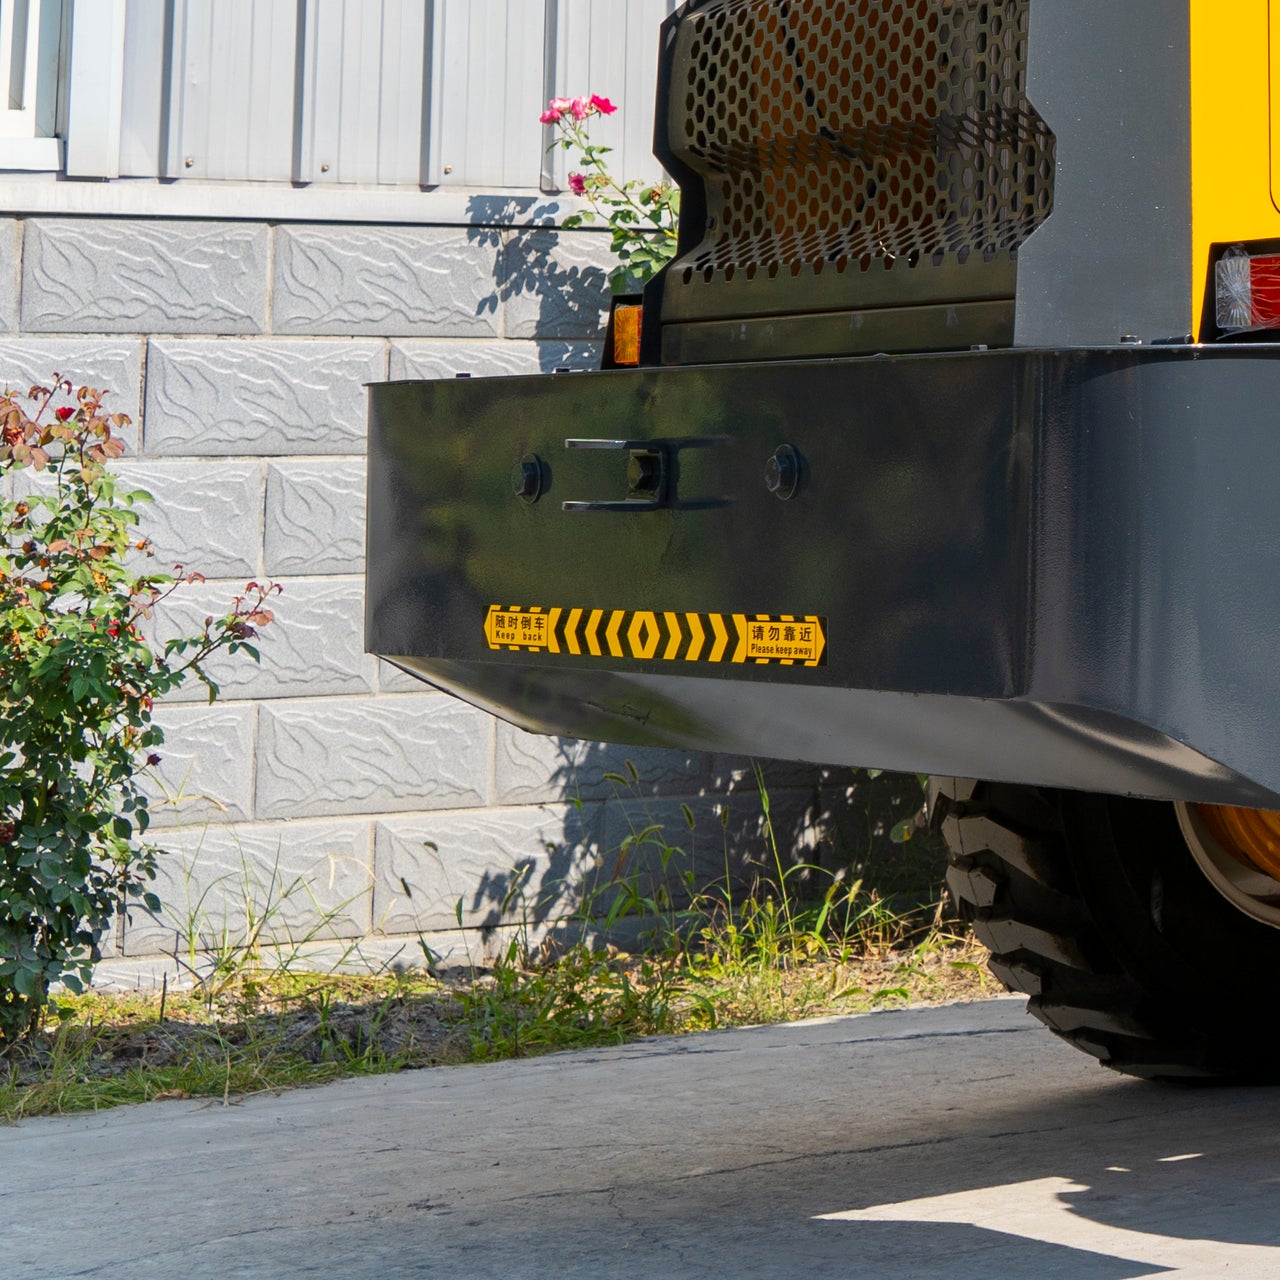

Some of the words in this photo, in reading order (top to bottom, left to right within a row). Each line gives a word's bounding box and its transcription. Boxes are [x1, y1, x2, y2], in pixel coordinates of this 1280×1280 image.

[495, 614, 545, 631] 随时倒车
[496, 630, 515, 641] Keep
[523, 631, 542, 641] back
[752, 625, 812, 642] 请勿靠近
[751, 643, 774, 655] Please
[776, 644, 792, 657] keep
[794, 646, 812, 658] away
